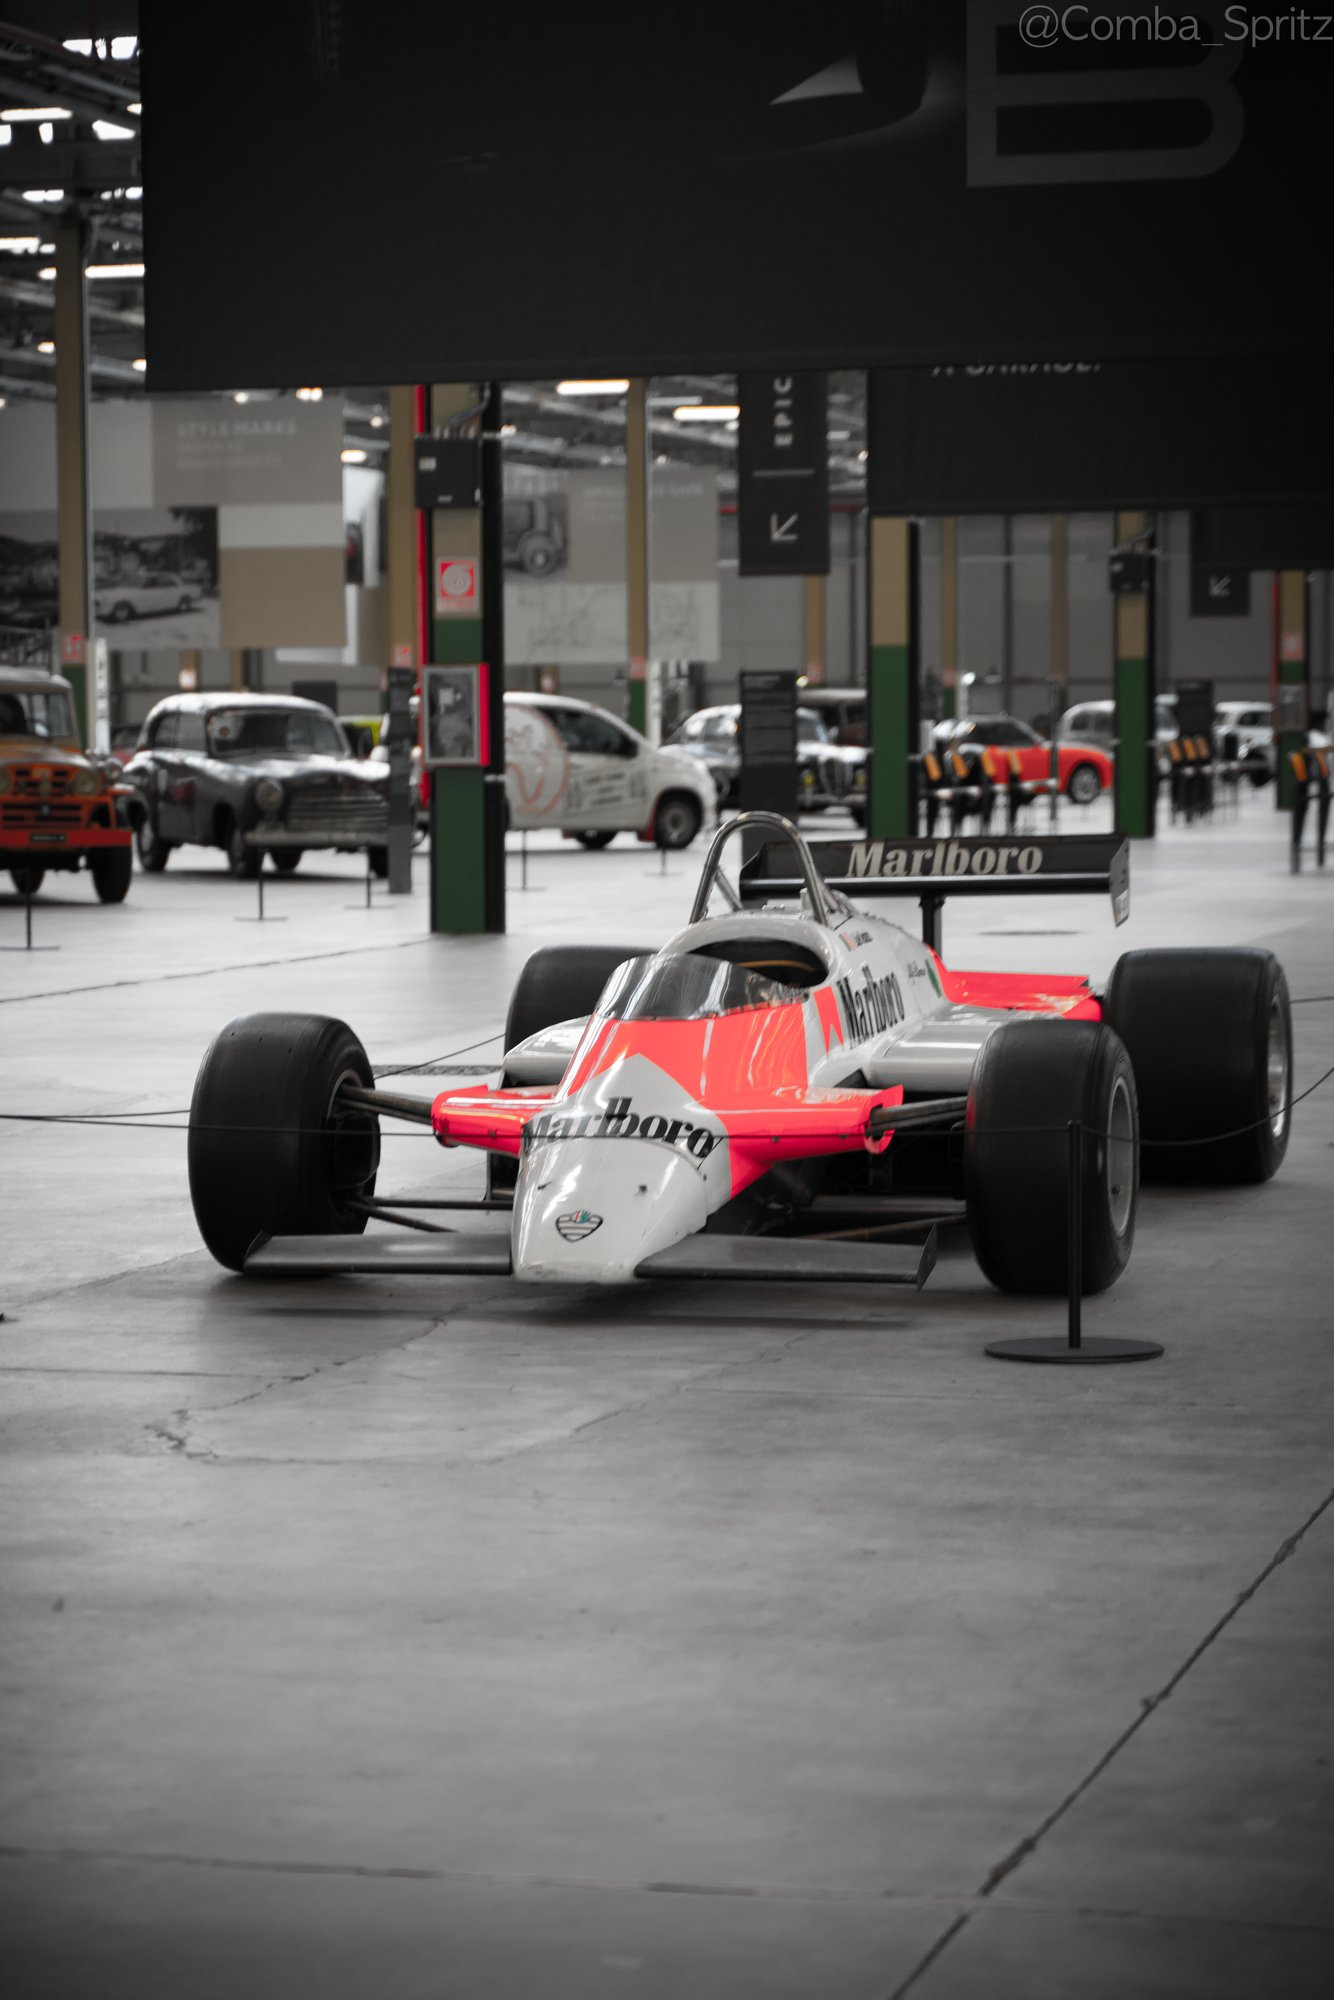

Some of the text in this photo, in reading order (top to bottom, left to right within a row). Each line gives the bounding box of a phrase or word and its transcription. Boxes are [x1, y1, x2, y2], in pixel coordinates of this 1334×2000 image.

[845, 841, 1043, 878] Marlboro
[836, 964, 905, 1051] Marlboro
[521, 1097, 715, 1159] Marlboro
